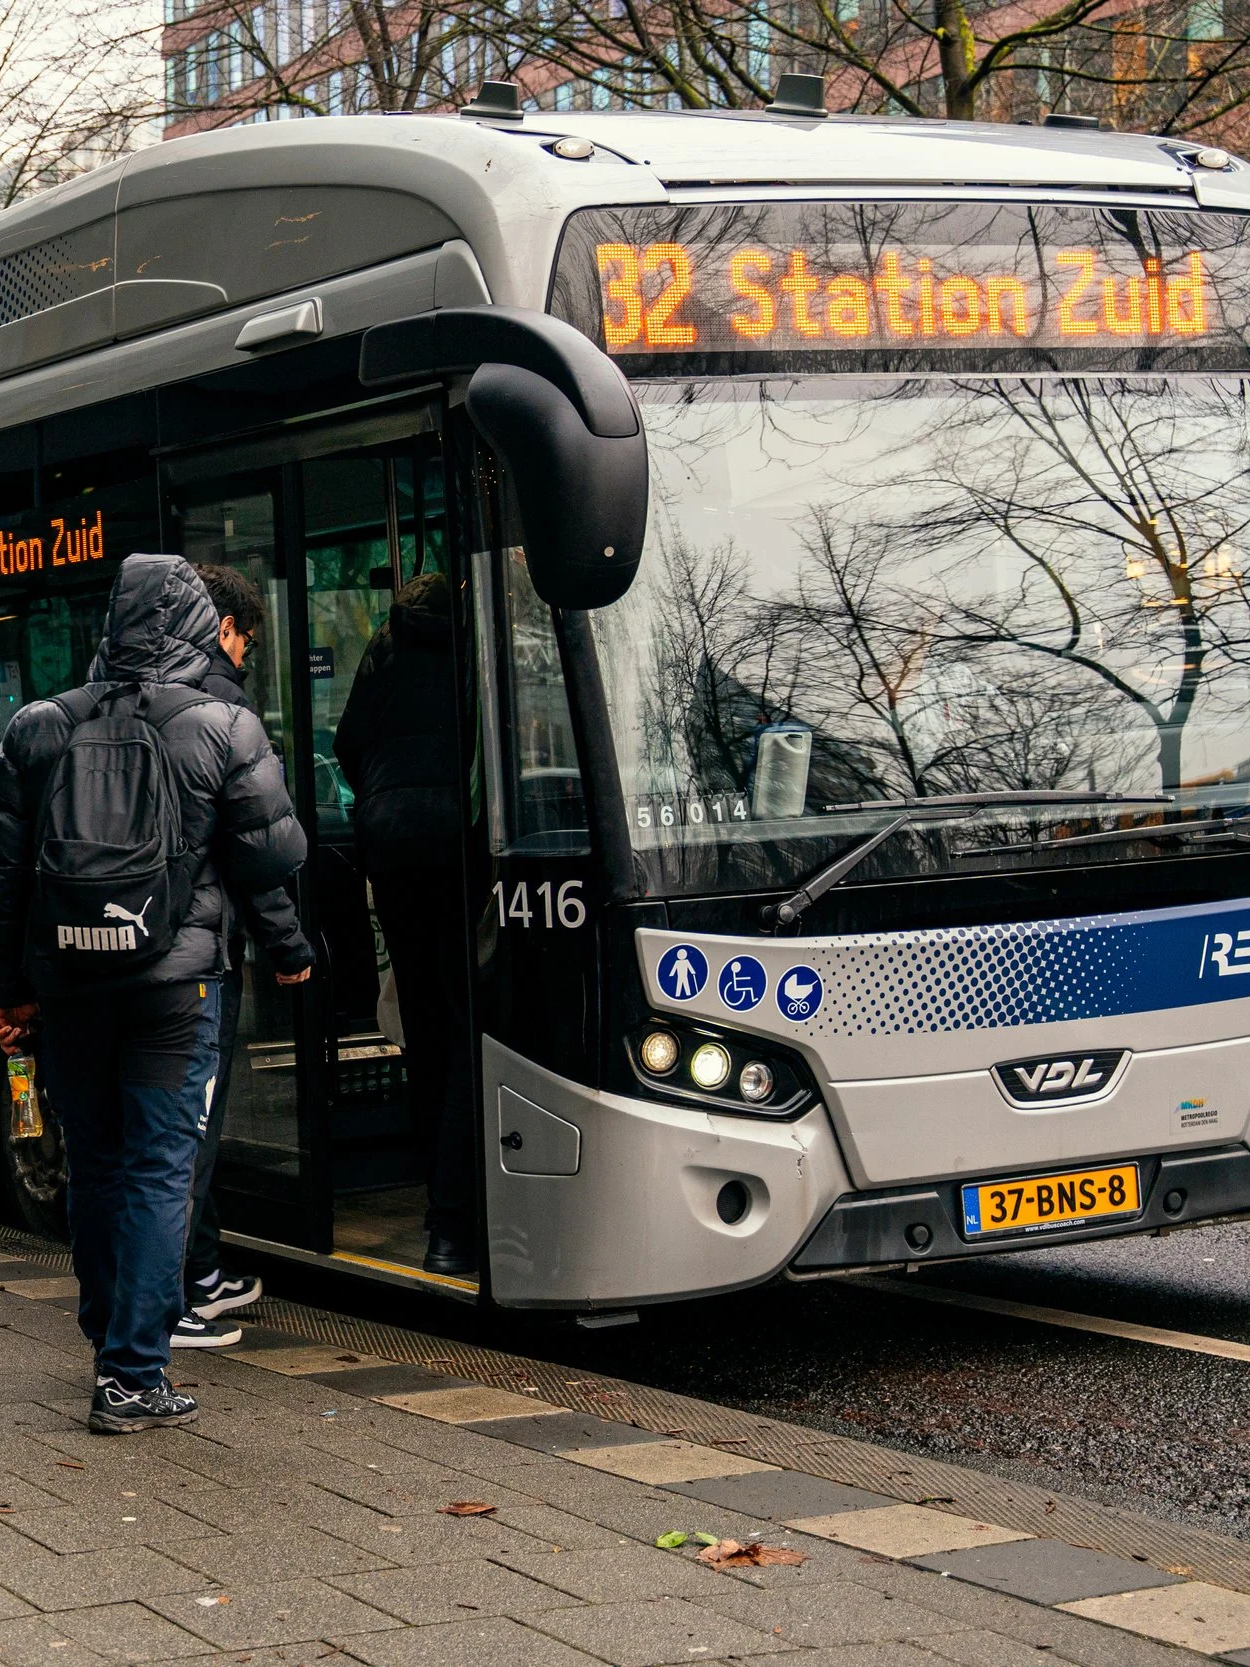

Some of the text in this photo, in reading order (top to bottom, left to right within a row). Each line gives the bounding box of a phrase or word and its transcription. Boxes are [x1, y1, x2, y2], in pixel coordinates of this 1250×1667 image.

[596, 243, 1206, 345] 32 Station Zuid
[51, 511, 103, 566] Zuid
[491, 880, 586, 929] 1416
[57, 925, 137, 951] PUMA
[1013, 1058, 1103, 1093] VDL
[966, 1215, 979, 1225] NL
[990, 1174, 1126, 1223] 37-BNS-8
